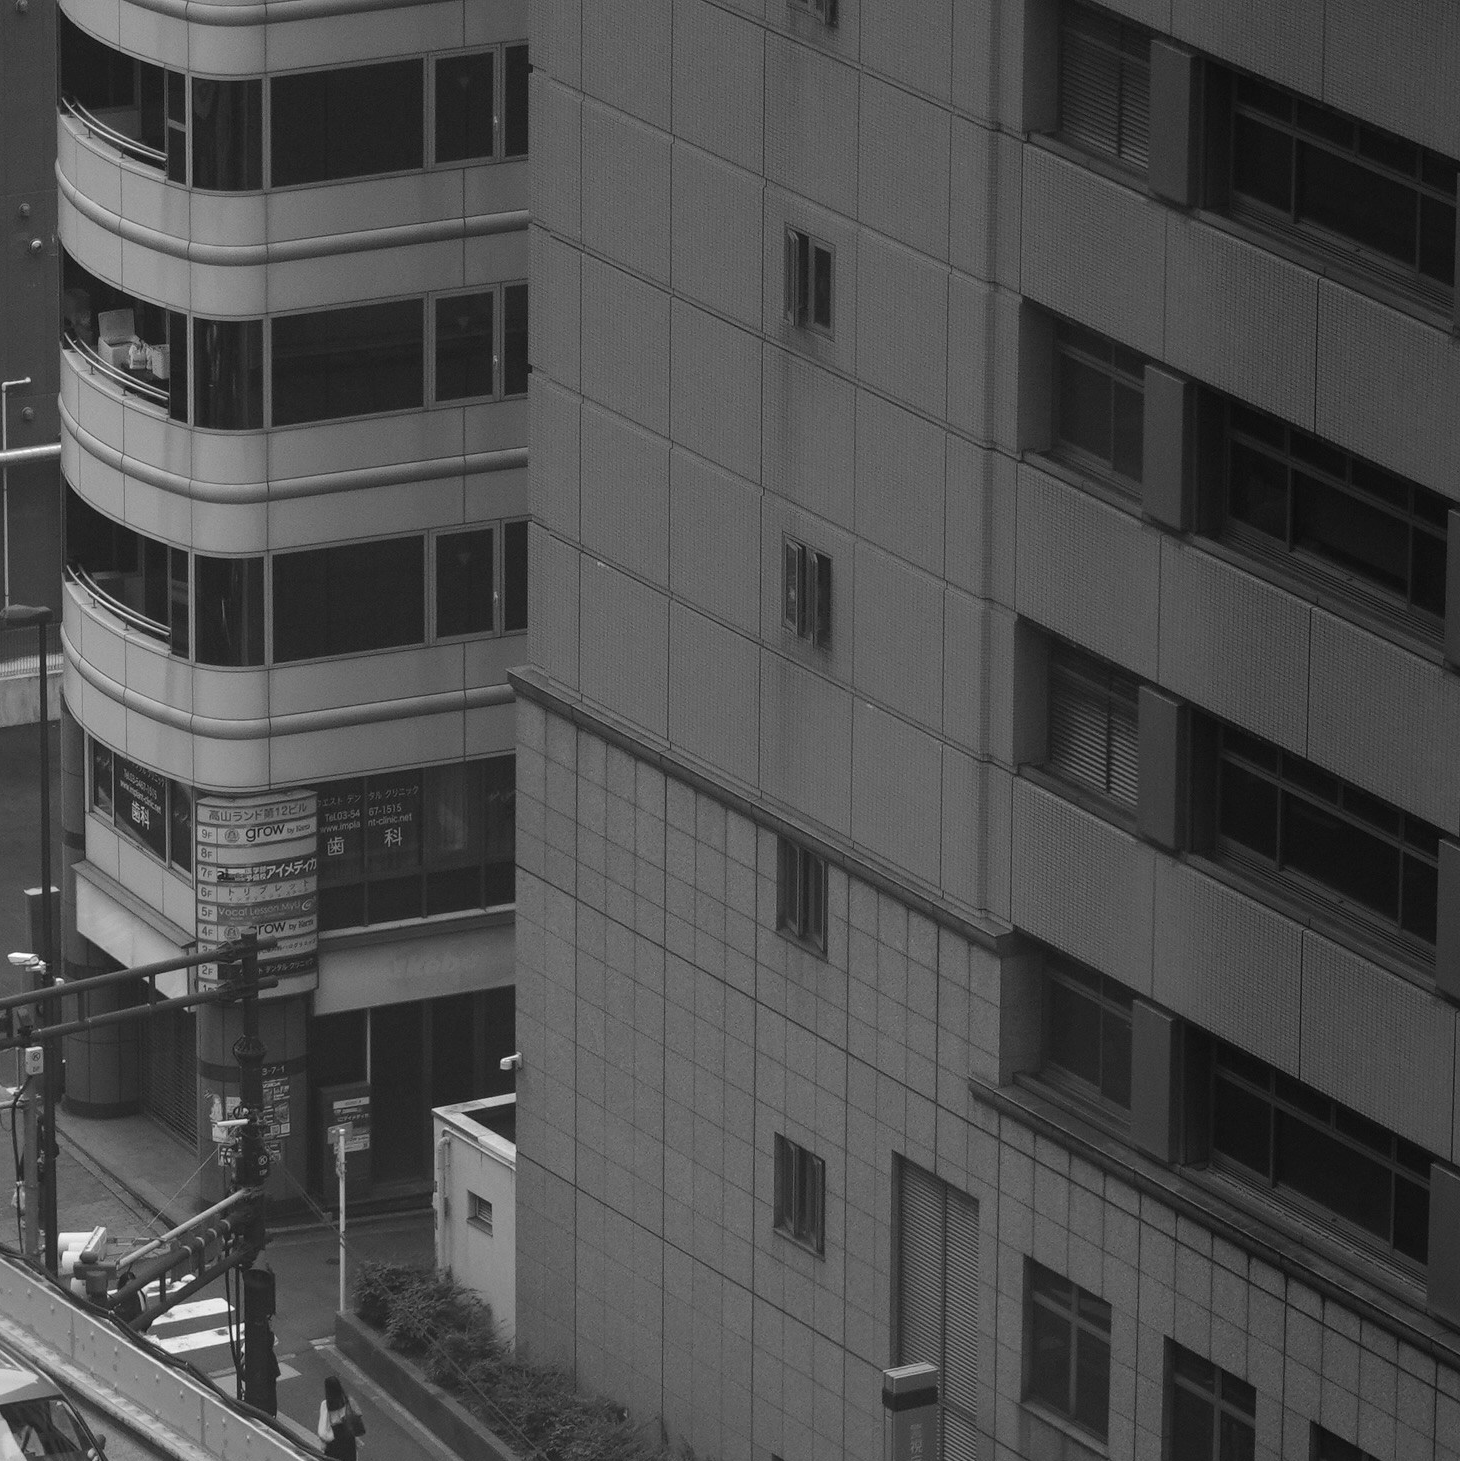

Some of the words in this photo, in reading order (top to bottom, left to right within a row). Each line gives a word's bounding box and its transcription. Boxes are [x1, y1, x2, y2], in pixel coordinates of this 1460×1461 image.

[131, 799, 150, 831] 歯科
[209, 803, 307, 822] 高山ランド第12ビル
[201, 829, 213, 839] 9F
[245, 824, 285, 843] grow
[201, 848, 213, 858] 8F
[201, 867, 213, 878] 7F
[266, 858, 317, 879] アイメディカ
[201, 887, 213, 897] 6F
[201, 907, 213, 917] 5F
[218, 907, 247, 917] Vocal
[249, 903, 280, 916] Lesson
[201, 926, 213, 937] 4F
[249, 922, 286, 936] row
[201, 965, 213, 975] 2F
[262, 1065, 285, 1076] 3-7-1
